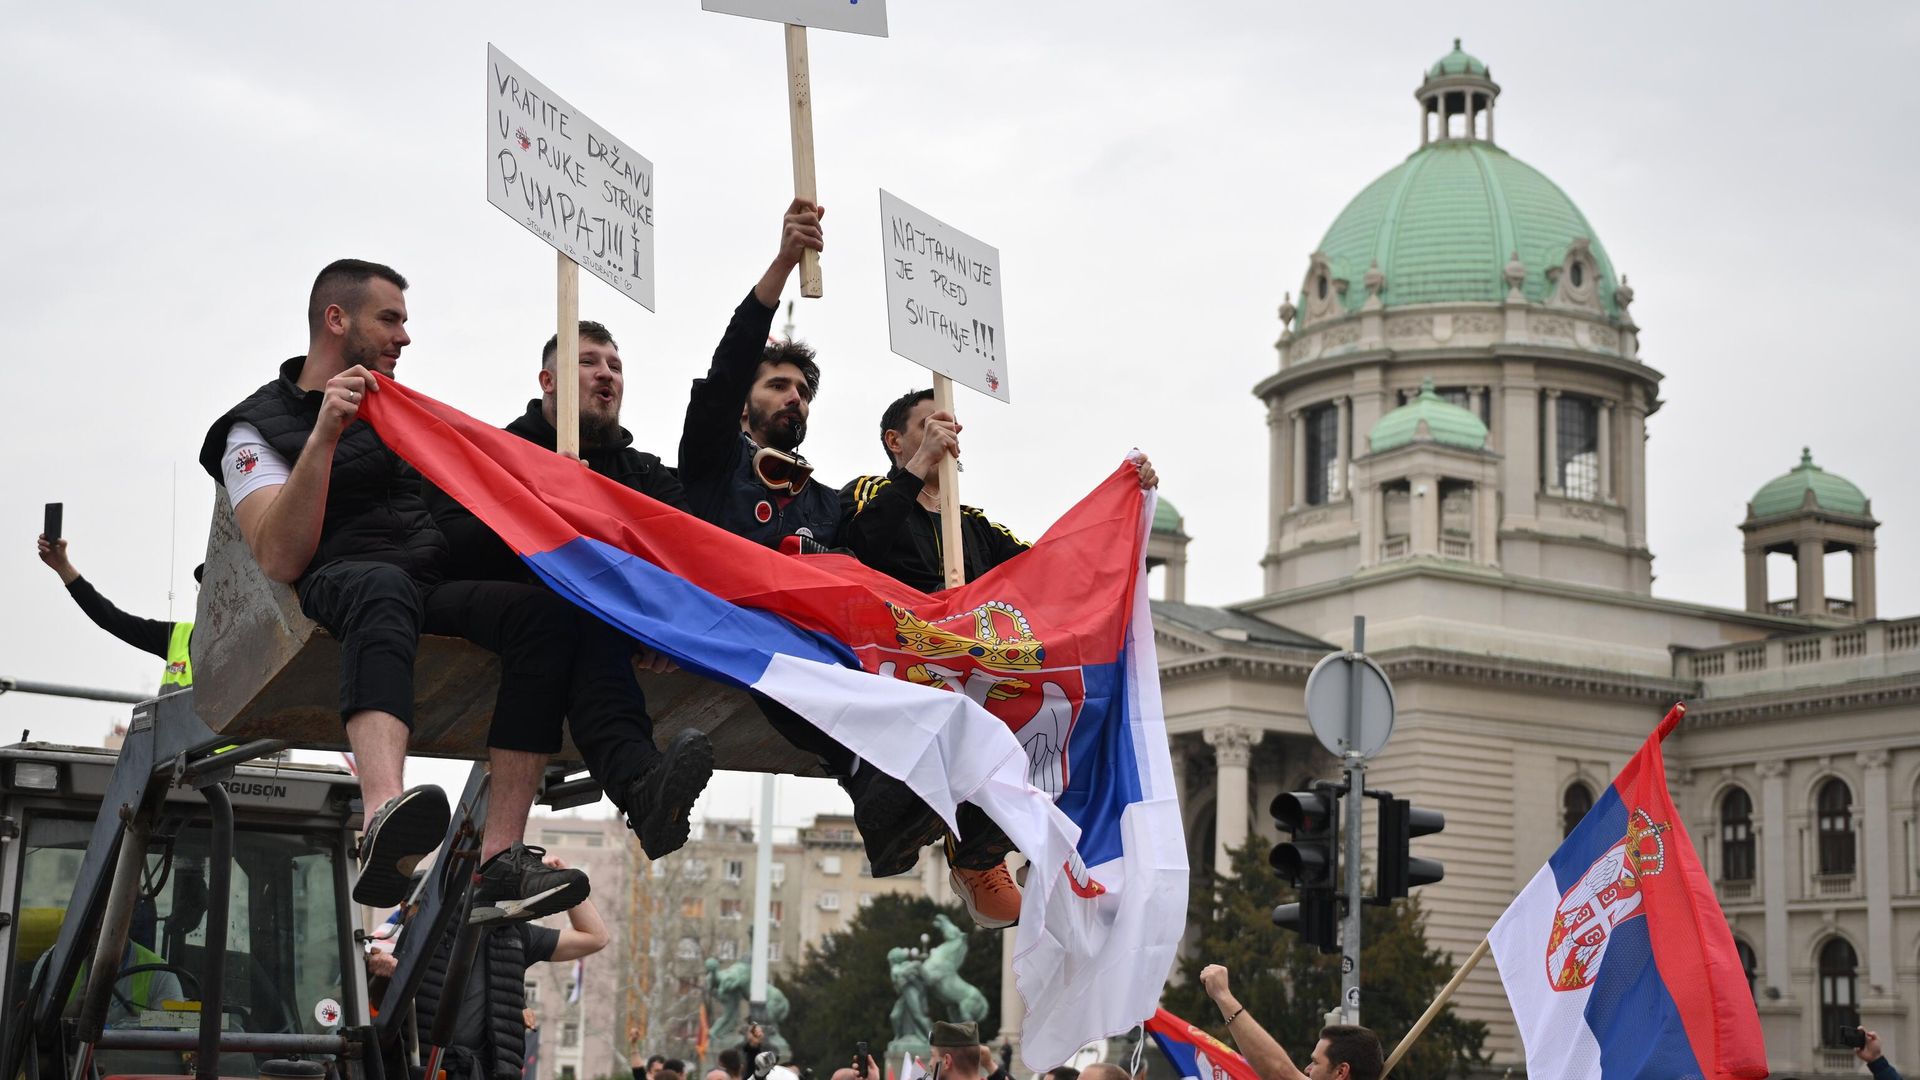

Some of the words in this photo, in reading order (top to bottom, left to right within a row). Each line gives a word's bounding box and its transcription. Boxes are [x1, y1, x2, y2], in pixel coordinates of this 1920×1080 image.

[494, 62, 572, 140] VRATITE
[587, 133, 650, 197] DRŽAVU
[498, 110, 510, 139] U
[537, 137, 587, 187] RUKE
[602, 180, 654, 227] STRUKE
[891, 216, 992, 287] NAJTAMNIJE
[894, 258, 914, 280] JE
[930, 269, 968, 306] PRED
[905, 297, 995, 362] SVITANJE!!!
[221, 781, 287, 798] RGUSON
